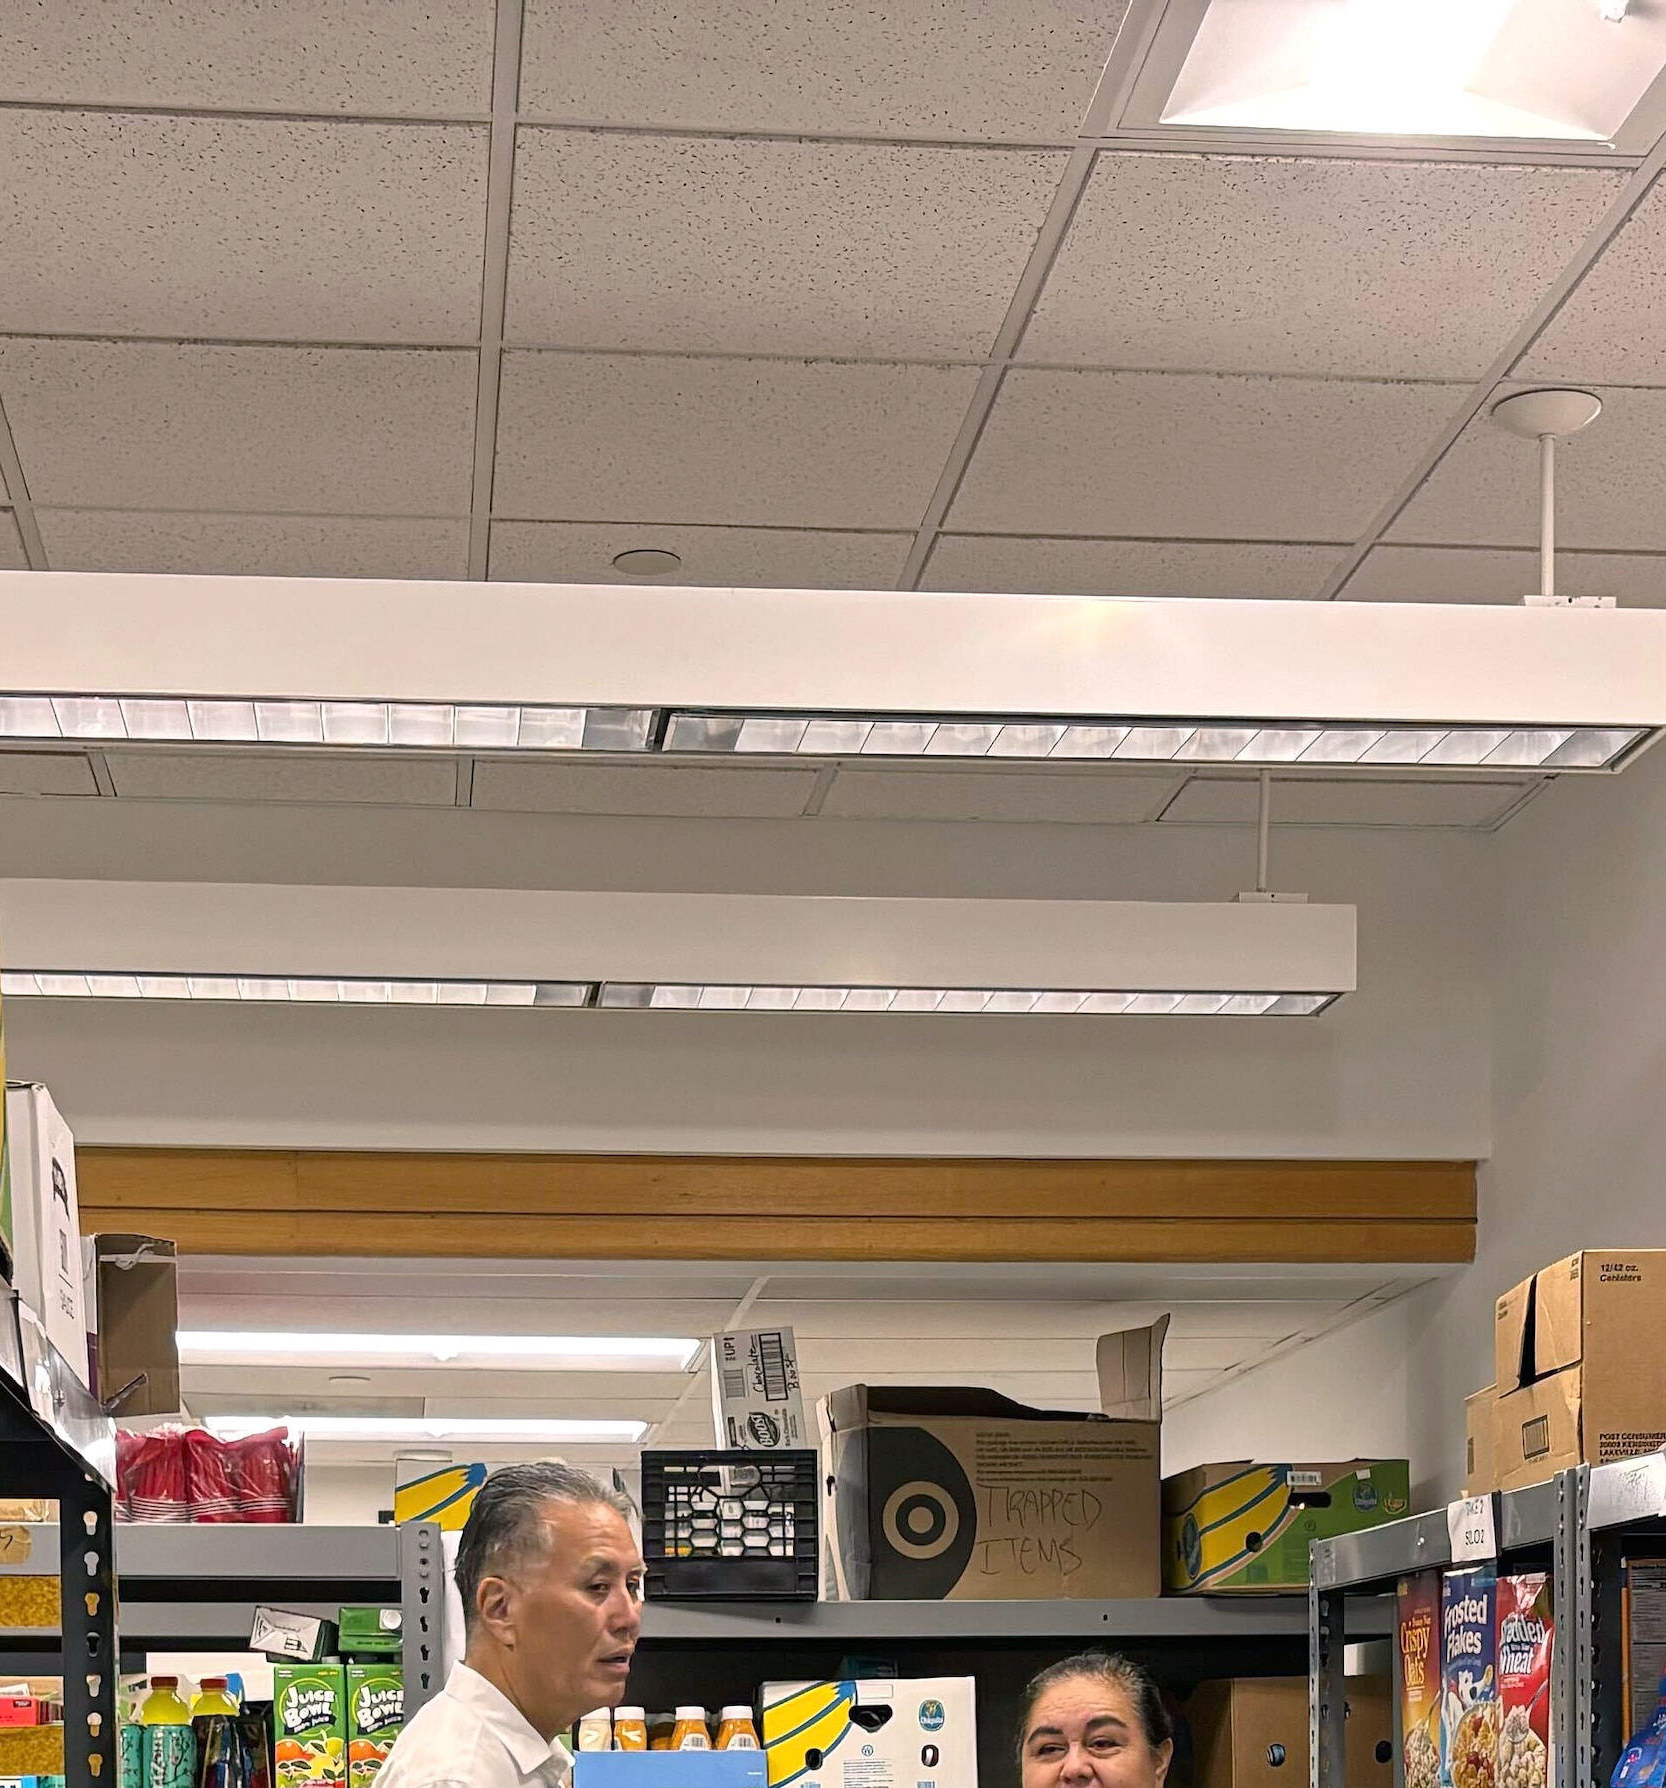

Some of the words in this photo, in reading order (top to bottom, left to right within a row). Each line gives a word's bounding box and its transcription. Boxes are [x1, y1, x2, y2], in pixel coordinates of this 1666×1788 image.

[752, 1414, 774, 1447] BOOST
[977, 1484, 1102, 1530] TRAPPED
[978, 1536, 1083, 1577] ITEMS
[1400, 1621, 1430, 1660] Crispy
[1446, 1629, 1482, 1663] Flakes
[1404, 1655, 1425, 1685] Oats
[286, 1686, 335, 1708] JUICE
[284, 1701, 333, 1728] BOWL
